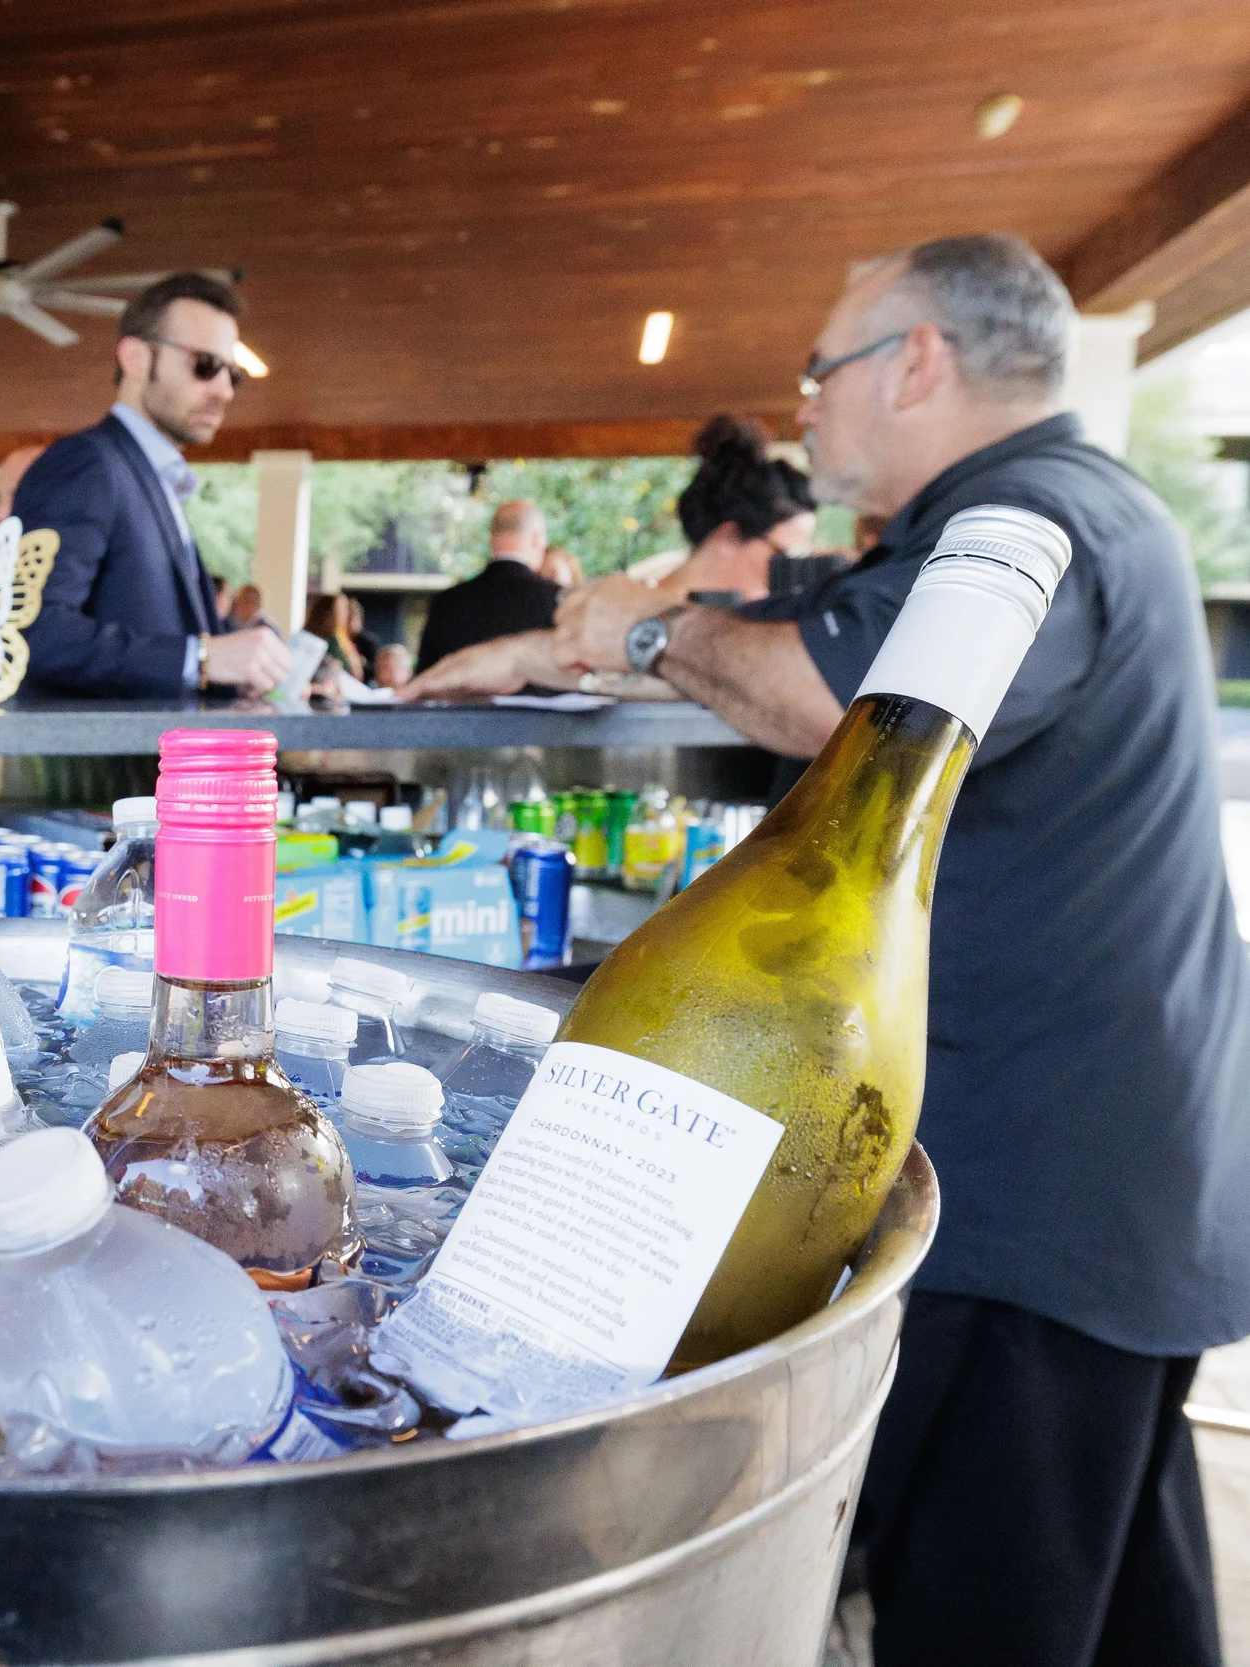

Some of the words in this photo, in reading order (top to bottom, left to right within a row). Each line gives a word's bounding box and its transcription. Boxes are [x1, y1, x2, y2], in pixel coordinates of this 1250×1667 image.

[172, 893, 199, 903] OWNED
[431, 899, 509, 936] mini
[545, 1063, 630, 1103] SILVER
[565, 1098, 661, 1141] VINEYARDS
[531, 1119, 622, 1155] CHARDONNAY
[636, 1158, 676, 1184] 2023
[591, 1161, 605, 1175] by
[602, 1168, 636, 1189] James
[528, 1174, 557, 1189] express
[559, 1185, 578, 1198] true
[581, 1195, 619, 1217] varietal
[537, 1157, 562, 1174] legacy
[564, 1170, 584, 1183] who
[640, 1206, 651, 1215] in
[653, 1213, 694, 1241] crafting
[499, 1211, 519, 1225] down
[521, 1221, 536, 1232] the
[536, 1229, 558, 1243] rush
[559, 1240, 572, 1249] of
[579, 1246, 604, 1267] busy
[508, 1183, 528, 1194] opens
[529, 1190, 543, 1200] the
[542, 1198, 566, 1210] gates
[568, 1206, 578, 1216] to
[586, 1216, 633, 1243] portfolio
[636, 1241, 650, 1251] of
[650, 1249, 679, 1269] wines
[510, 1200, 527, 1211] with
[534, 1210, 557, 1224] meal
[557, 1221, 567, 1230] or
[569, 1226, 592, 1241] even
[594, 1237, 606, 1247] to
[608, 1246, 637, 1264] enjoy
[639, 1263, 649, 1272] as
[653, 1269, 672, 1285] you
[483, 1230, 529, 1255] Chardonnay
[541, 1258, 624, 1305] medium-bodied
[493, 1254, 504, 1262] of
[502, 1259, 526, 1273] apple
[527, 1270, 547, 1283] and
[547, 1281, 575, 1298] notes
[577, 1296, 591, 1306] of
[591, 1304, 626, 1327] vanilla
[536, 1291, 583, 1322] balanced
